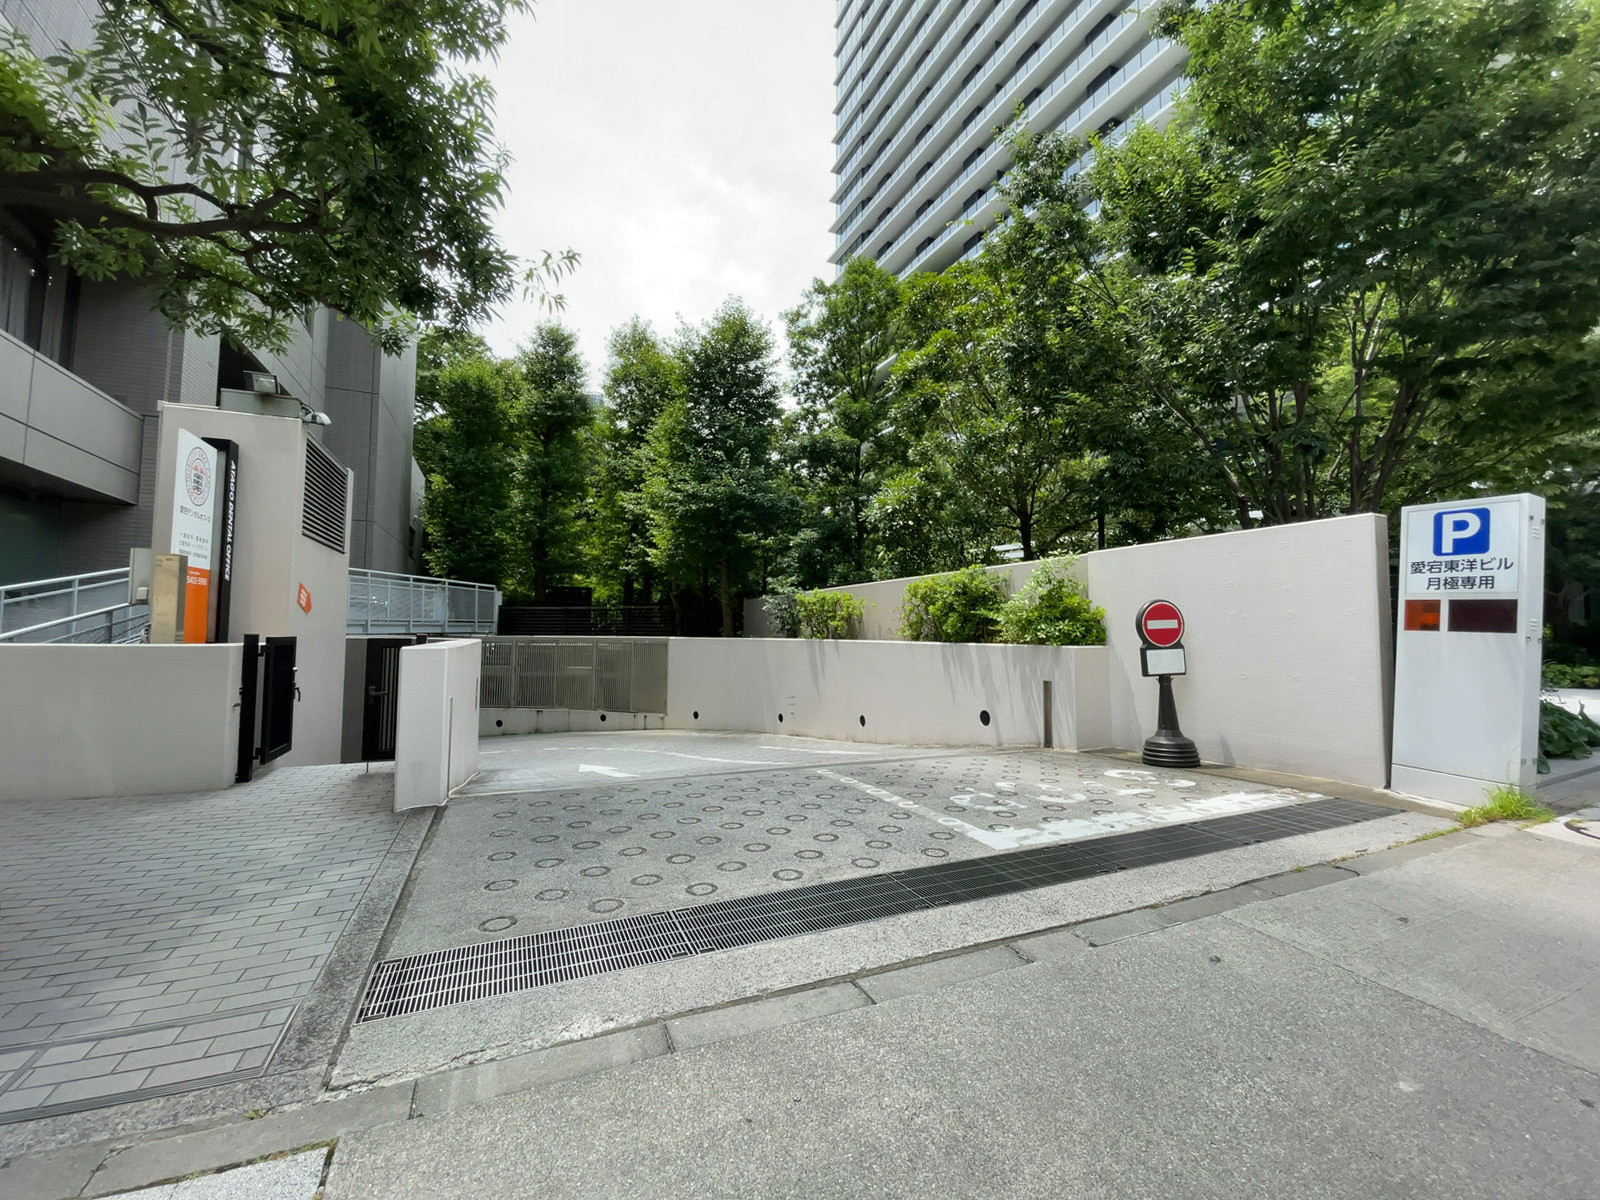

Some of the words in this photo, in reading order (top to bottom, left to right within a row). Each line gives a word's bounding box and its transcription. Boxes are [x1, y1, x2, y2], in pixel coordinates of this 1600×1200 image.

[229, 460, 237, 501] ATAGO
[226, 502, 235, 543] DENTAL
[1442, 512, 1481, 553] P
[224, 544, 232, 581] OFFICE
[1410, 557, 1514, 575] 愛宕東洋ビル
[1426, 575, 1495, 591] 月極専用
